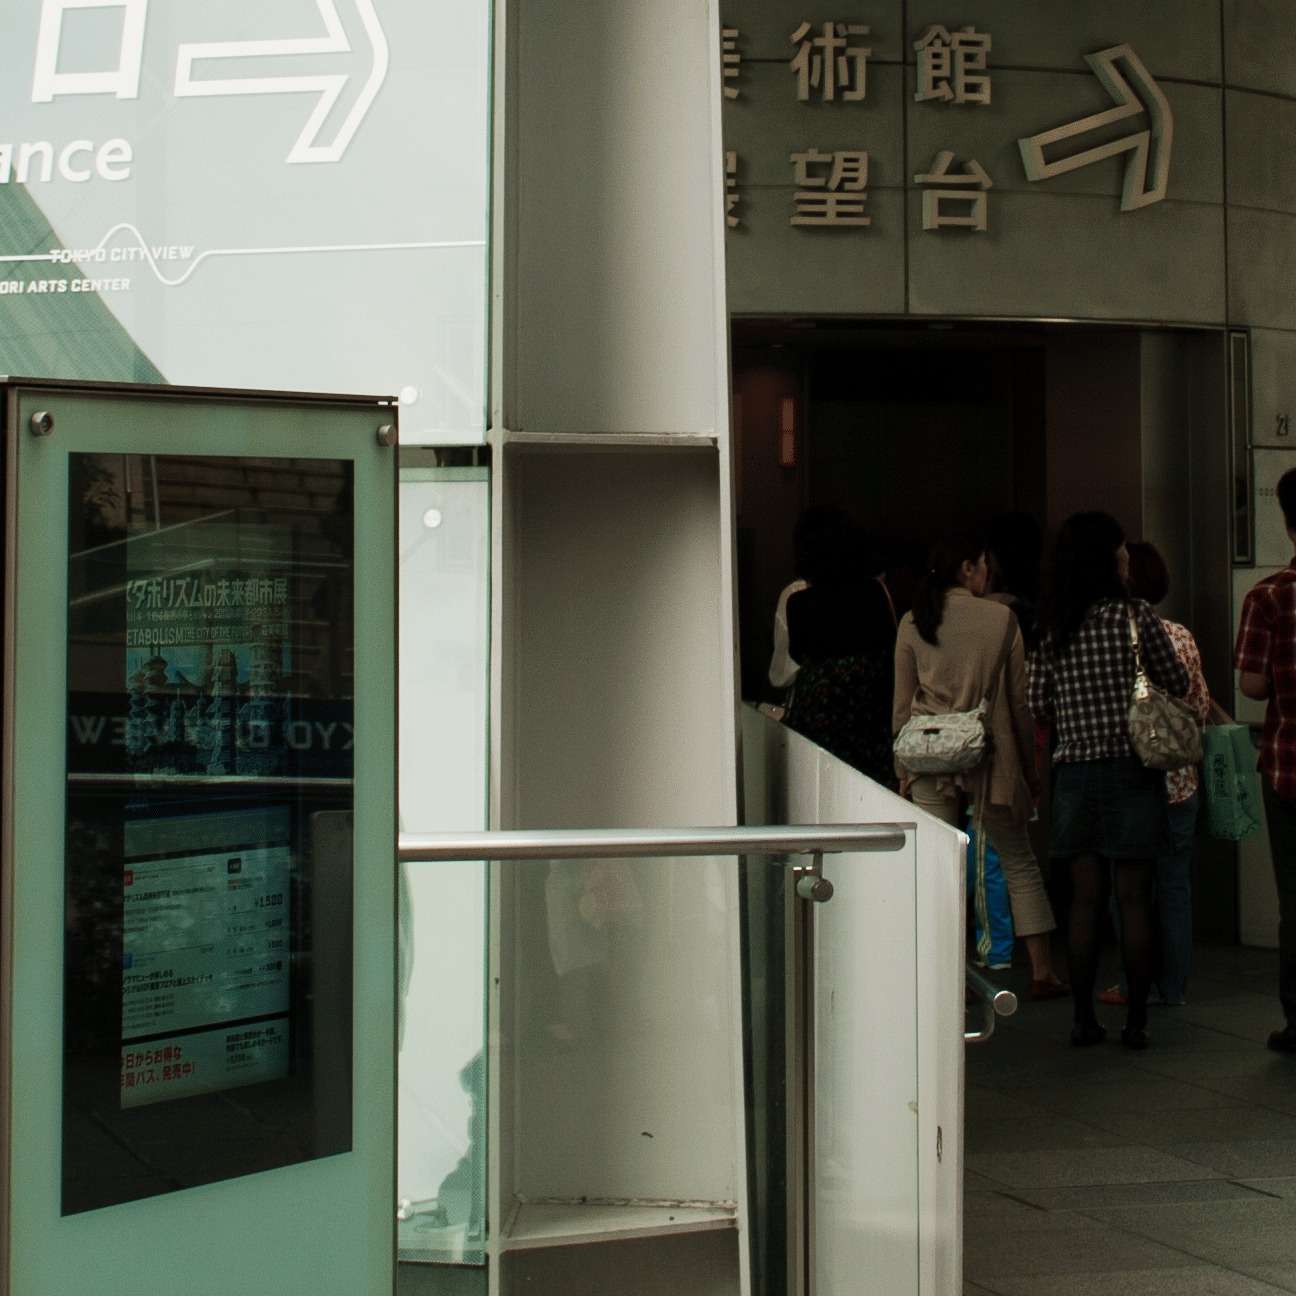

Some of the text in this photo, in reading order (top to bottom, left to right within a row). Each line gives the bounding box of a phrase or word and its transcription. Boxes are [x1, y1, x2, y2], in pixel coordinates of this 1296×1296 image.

[110, 247, 147, 263] CITY
[154, 245, 195, 260] VIEW
[27, 279, 67, 293] ARTS
[71, 278, 131, 292] CENTER
[120, 1045, 183, 1071] 日からお得な
